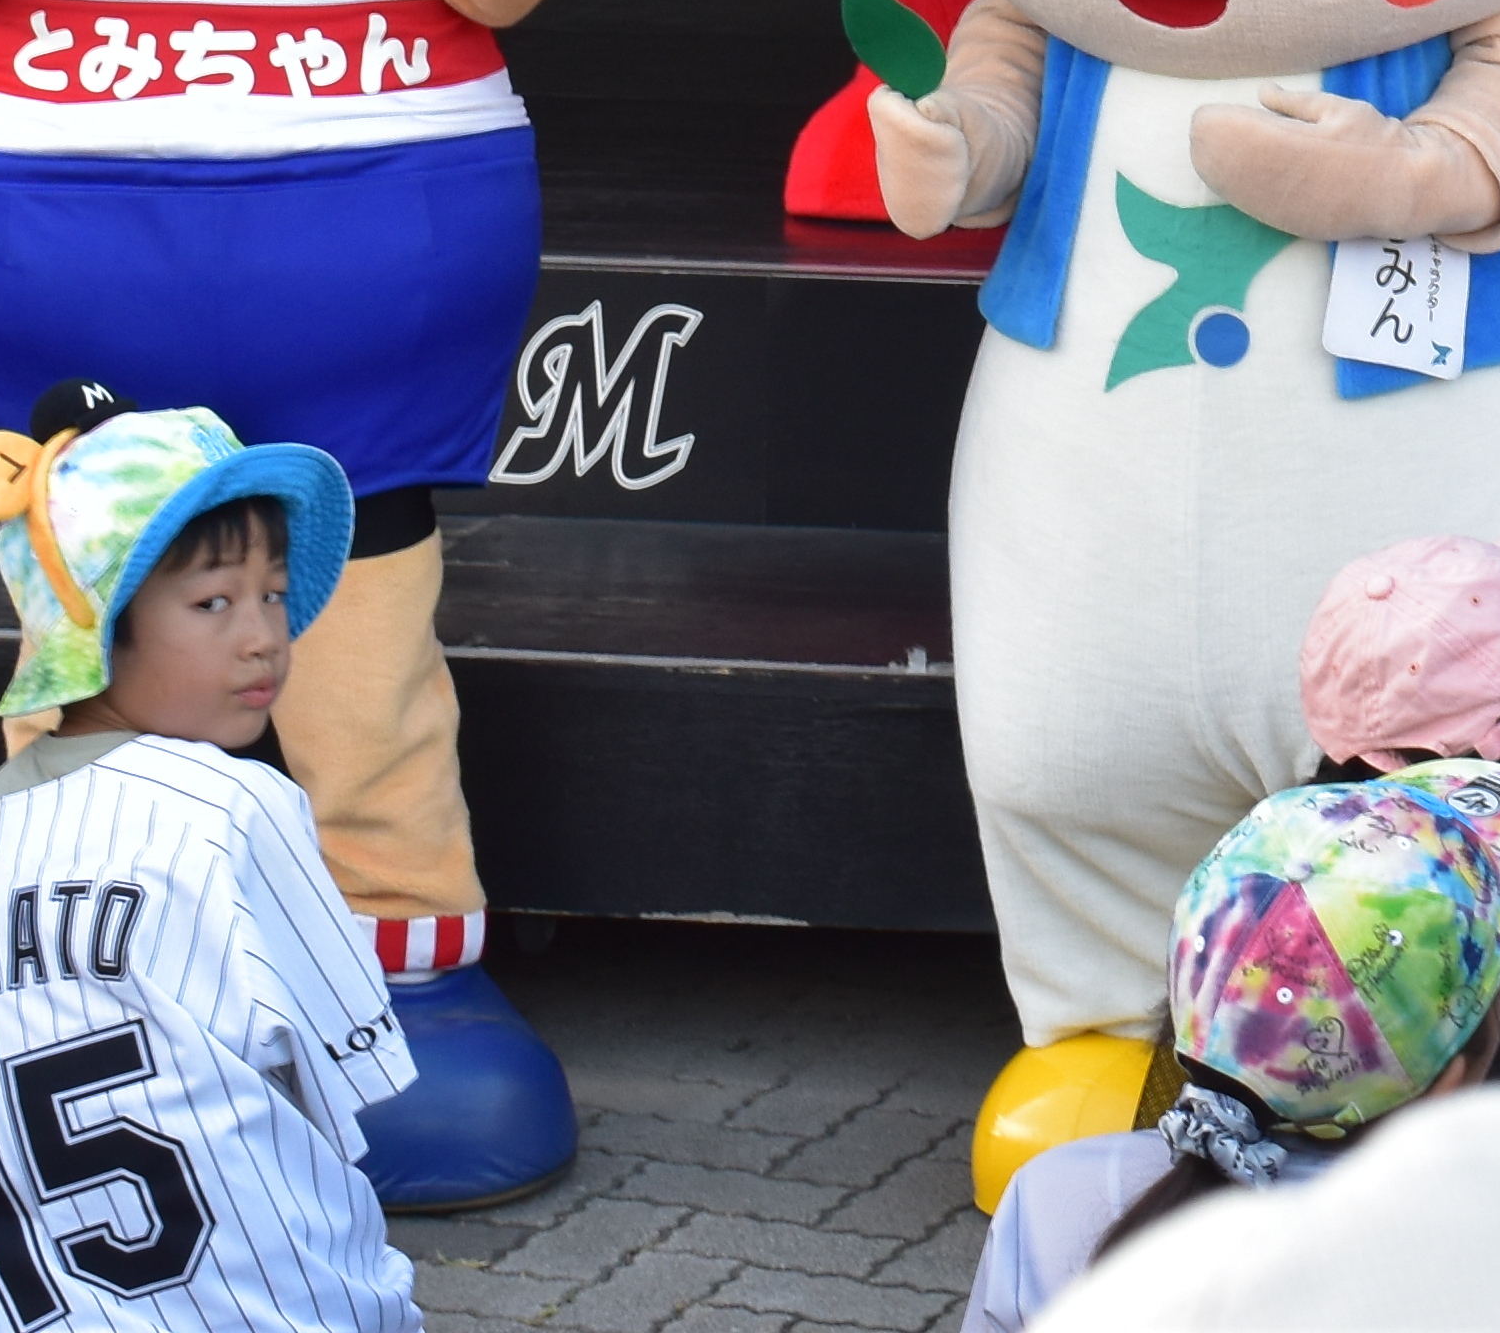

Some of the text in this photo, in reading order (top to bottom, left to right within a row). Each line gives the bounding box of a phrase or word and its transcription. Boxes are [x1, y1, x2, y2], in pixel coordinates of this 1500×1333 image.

[12, 9, 431, 102] とみちゃん
[1369, 237, 1418, 345] みん
[487, 298, 705, 492] M
